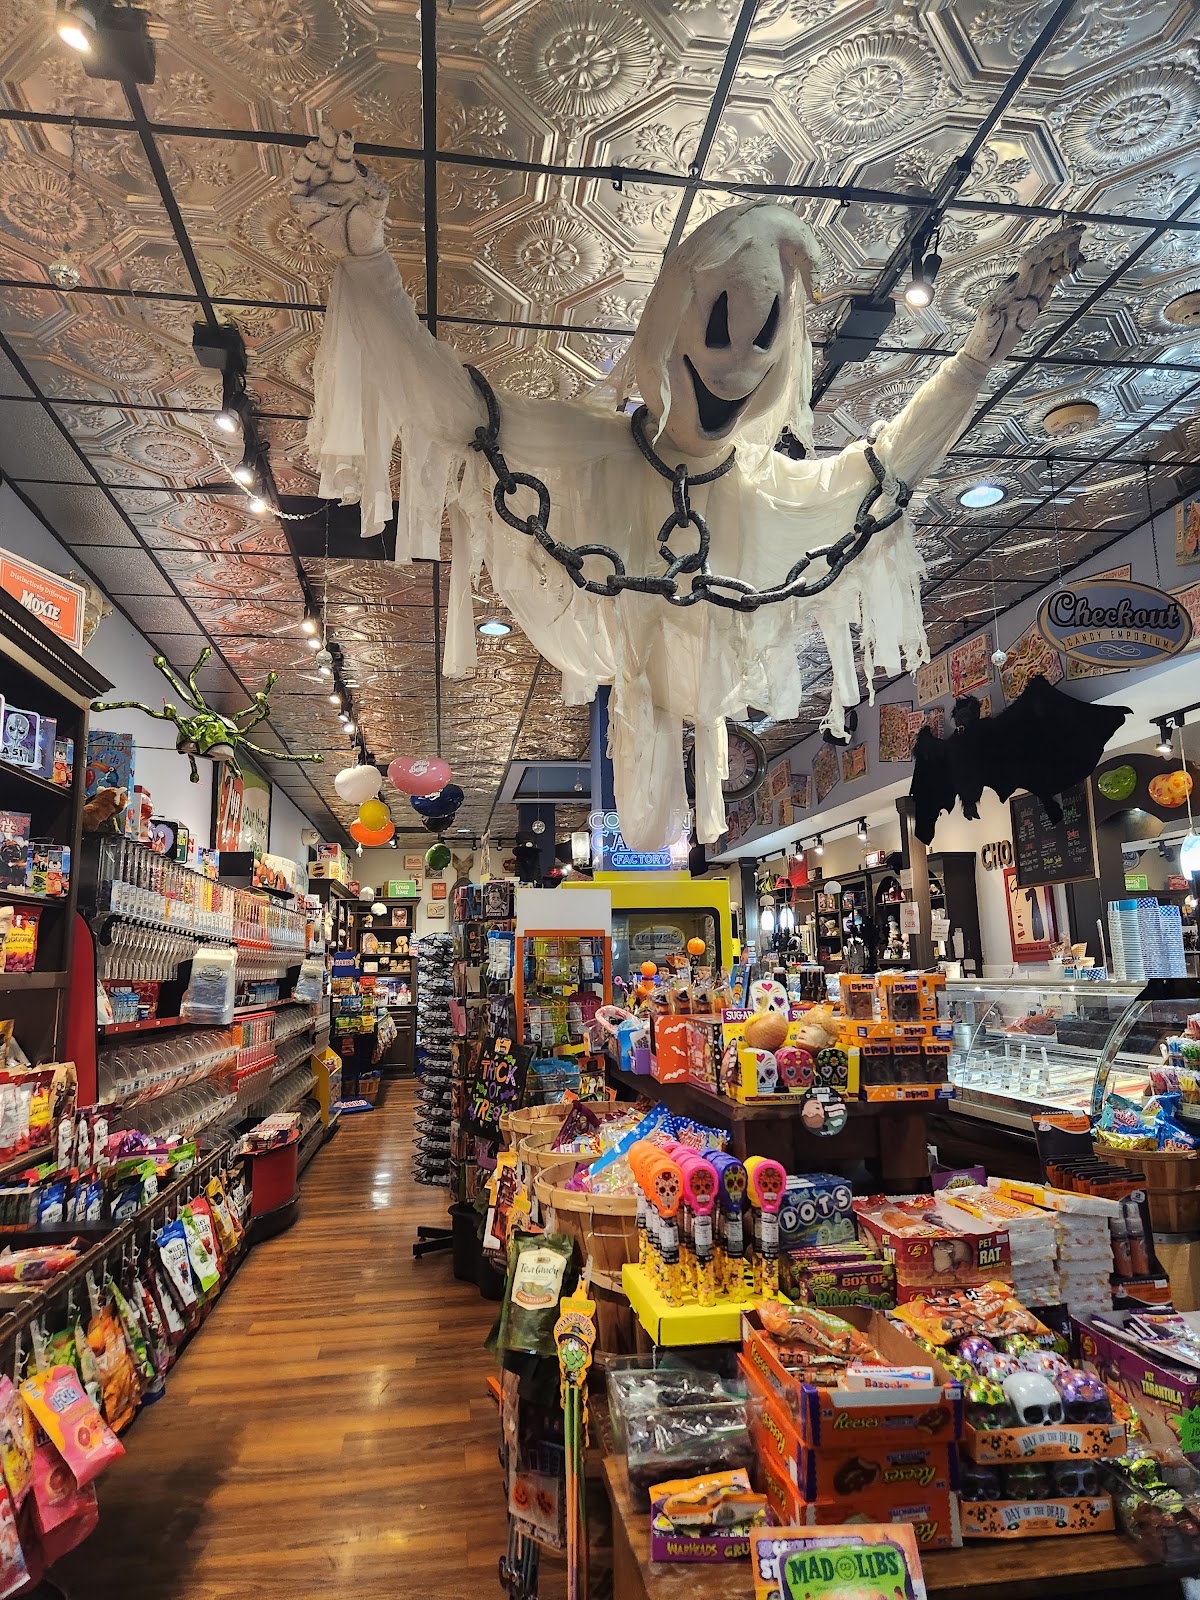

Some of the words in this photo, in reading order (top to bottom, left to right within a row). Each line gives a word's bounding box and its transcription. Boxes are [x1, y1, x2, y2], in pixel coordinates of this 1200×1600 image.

[10, 570, 45, 593] Distinctively
[45, 587, 70, 603] Different!
[20, 589, 61, 621] MOXIE
[1048, 590, 1180, 629] Checkout
[1066, 631, 1101, 647] CANDY
[1110, 630, 1170, 648] EMPORIUM
[616, 855, 668, 864] FACTORY
[784, 1189, 846, 1230] DOTS
[978, 1237, 993, 1248] PET
[979, 1246, 1002, 1265] RAT
[520, 1262, 535, 1273] Tea
[535, 1262, 559, 1279] Candy
[808, 1274, 836, 1289] SOUR
[842, 1274, 867, 1287] BOX
[870, 1274, 888, 1284] OF
[977, 1299, 1004, 1315] Corn
[864, 1377, 910, 1389] Bazooka
[1141, 1379, 1183, 1406] TARANTULA
[1022, 1434, 1037, 1448] DAY
[1046, 1432, 1058, 1441] THE
[1059, 1431, 1079, 1447] DEAD
[1004, 1507, 1021, 1521] DAY
[1031, 1505, 1044, 1515] THE
[1046, 1504, 1066, 1520] DEAD
[666, 1541, 718, 1557] WARHEADS
[788, 1555, 834, 1585] MAD
[853, 1551, 900, 1578] LIBS
